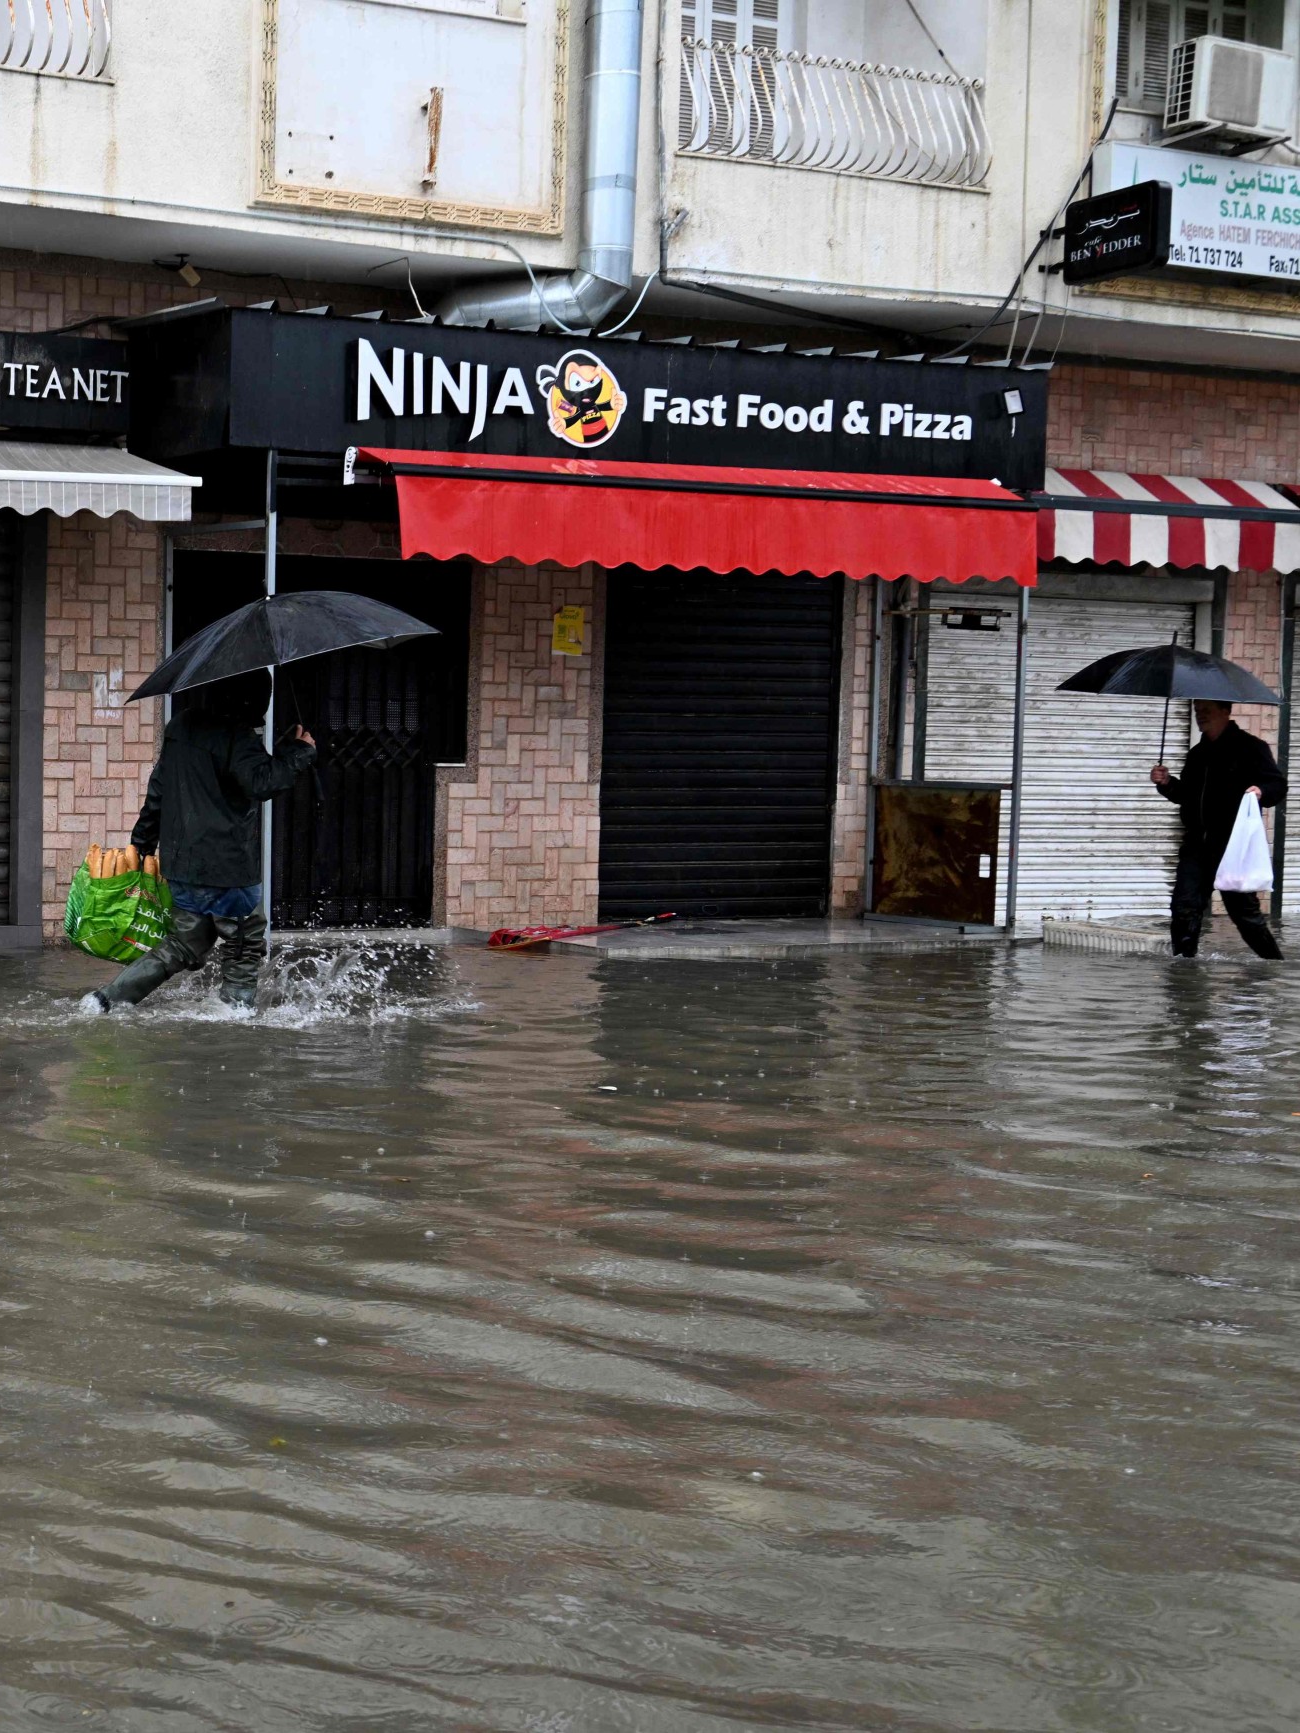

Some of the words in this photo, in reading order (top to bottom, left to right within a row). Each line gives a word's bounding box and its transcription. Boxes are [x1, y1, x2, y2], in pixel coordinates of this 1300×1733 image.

[1177, 163, 1218, 188] ستار
[1225, 169, 1285, 197] للتأمين
[1180, 219, 1214, 241] Agence
[1219, 224, 1251, 245] HATEM
[1070, 246, 1092, 262] BEN
[1096, 235, 1142, 257] YEDDER
[1188, 246, 1201, 264] 71
[1203, 248, 1222, 266] 737
[1225, 250, 1243, 268] 724
[3, 362, 66, 400] TEA
[72, 367, 130, 404] NET
[357, 337, 535, 442] NINJA
[643, 387, 727, 427] Fast
[737, 393, 834, 435] Food
[842, 400, 870, 435] &
[880, 403, 972, 442] Pizza
